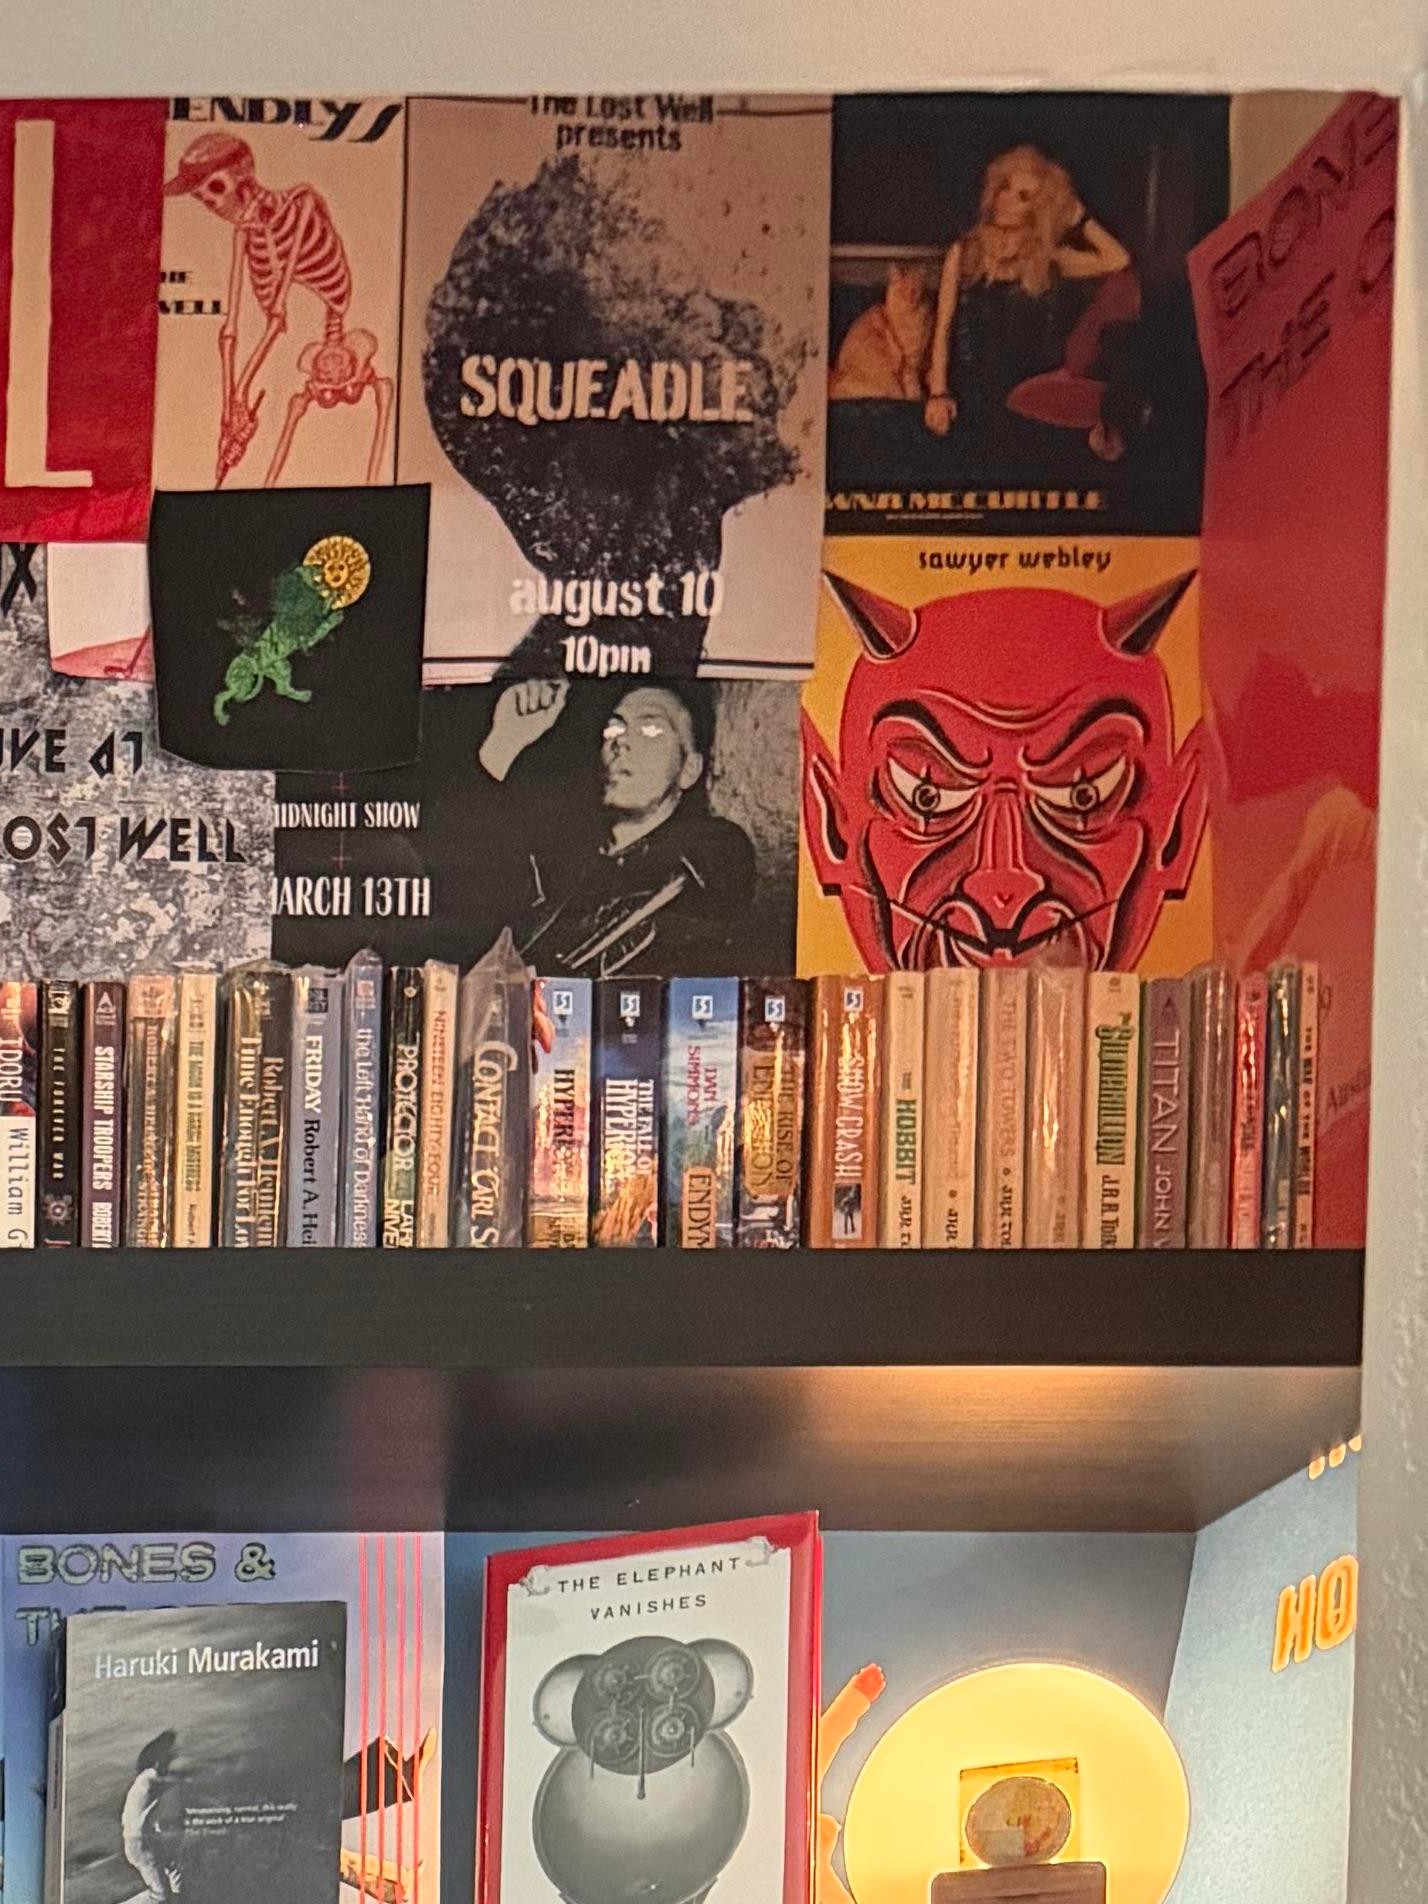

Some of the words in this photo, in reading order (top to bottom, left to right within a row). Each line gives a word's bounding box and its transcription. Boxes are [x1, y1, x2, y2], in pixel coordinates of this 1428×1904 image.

[459, 357, 755, 422] SQUEADLE
[917, 547, 1010, 575] sawyer
[1018, 545, 1112, 575] webley
[508, 571, 671, 625] august
[681, 571, 725, 618] 10
[562, 634, 654, 680] 10pm
[362, 799, 421, 831] SHOW
[117, 816, 246, 865] WELL
[362, 876, 432, 919] 13TH
[93, 1045, 113, 1113] STARSHIP
[305, 1034, 323, 1113] FRIDAY
[1152, 1033, 1181, 1156] TITAN
[895, 1098, 917, 1186] HOBBIT
[17, 1543, 217, 1585] BONES
[556, 1572, 603, 1594] THE
[614, 1555, 741, 1589] ELEPHANT
[589, 1593, 709, 1621] VANISHES
[94, 1648, 179, 1680] Haruki
[187, 1640, 320, 1675] Murakami
